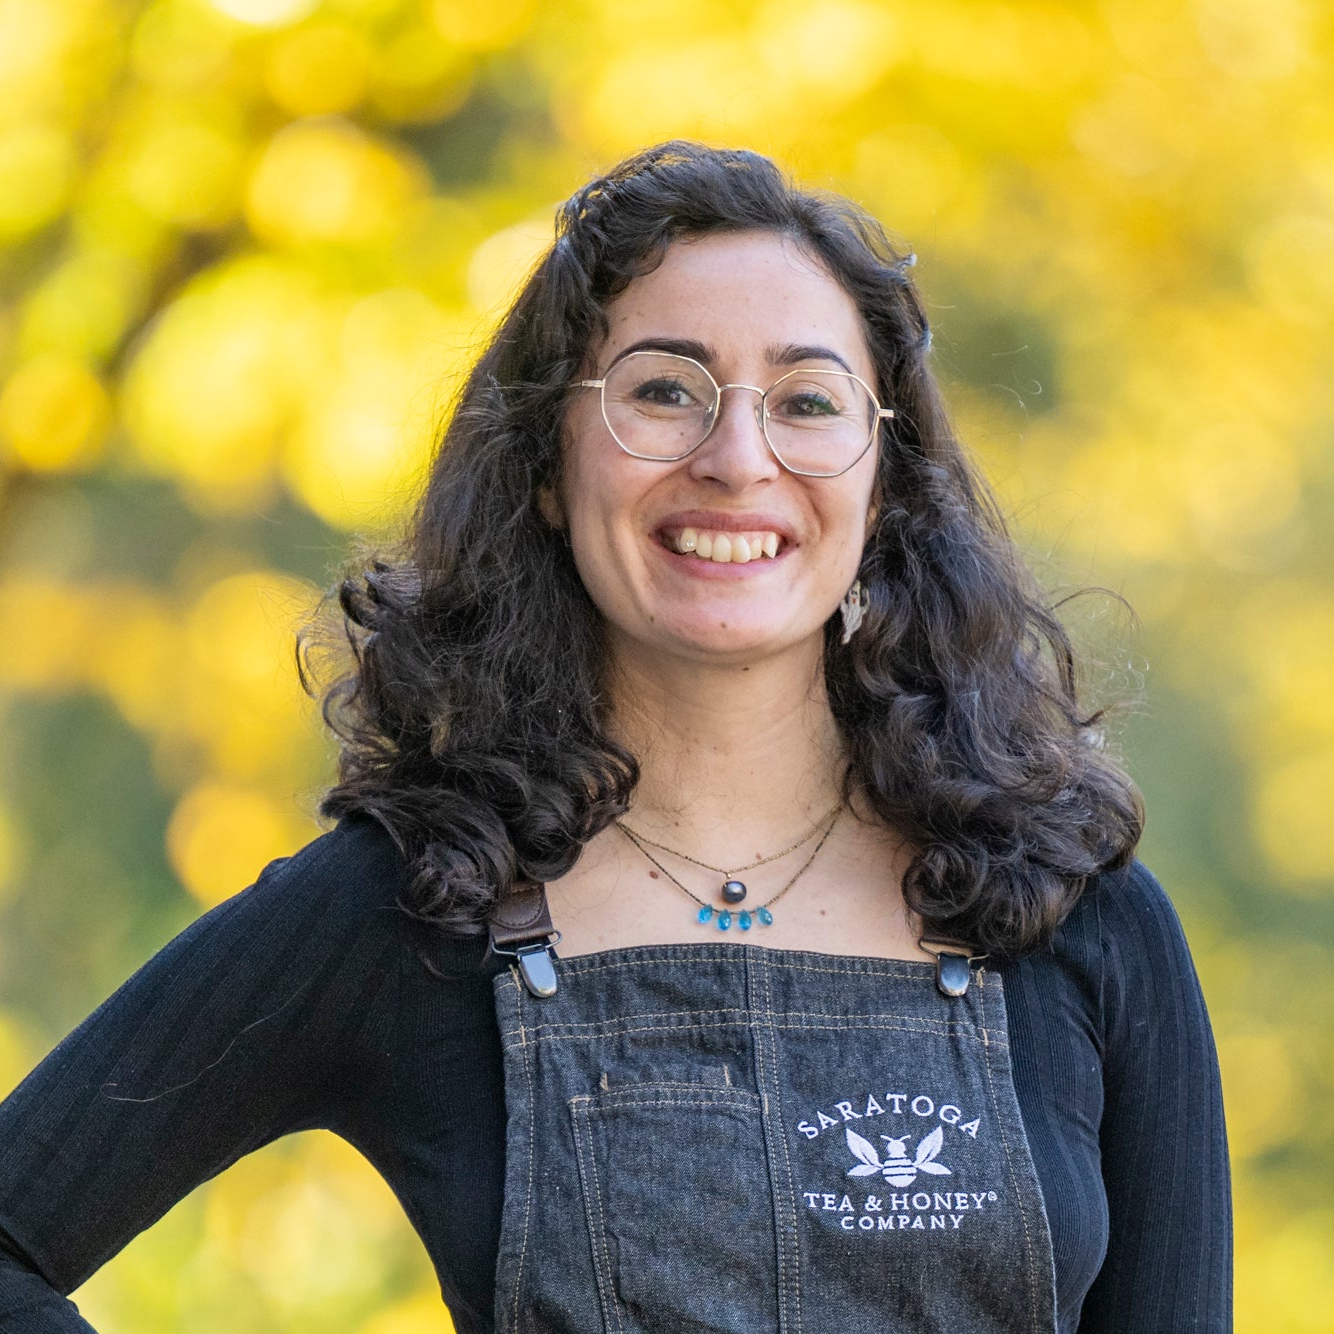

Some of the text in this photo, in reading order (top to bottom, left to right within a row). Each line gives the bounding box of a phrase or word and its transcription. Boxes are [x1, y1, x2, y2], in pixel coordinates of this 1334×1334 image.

[797, 1093, 981, 1140] SARATOGA
[803, 1192, 854, 1211] TEA
[865, 1195, 883, 1212] &
[840, 1214, 964, 1231] COMPANY
